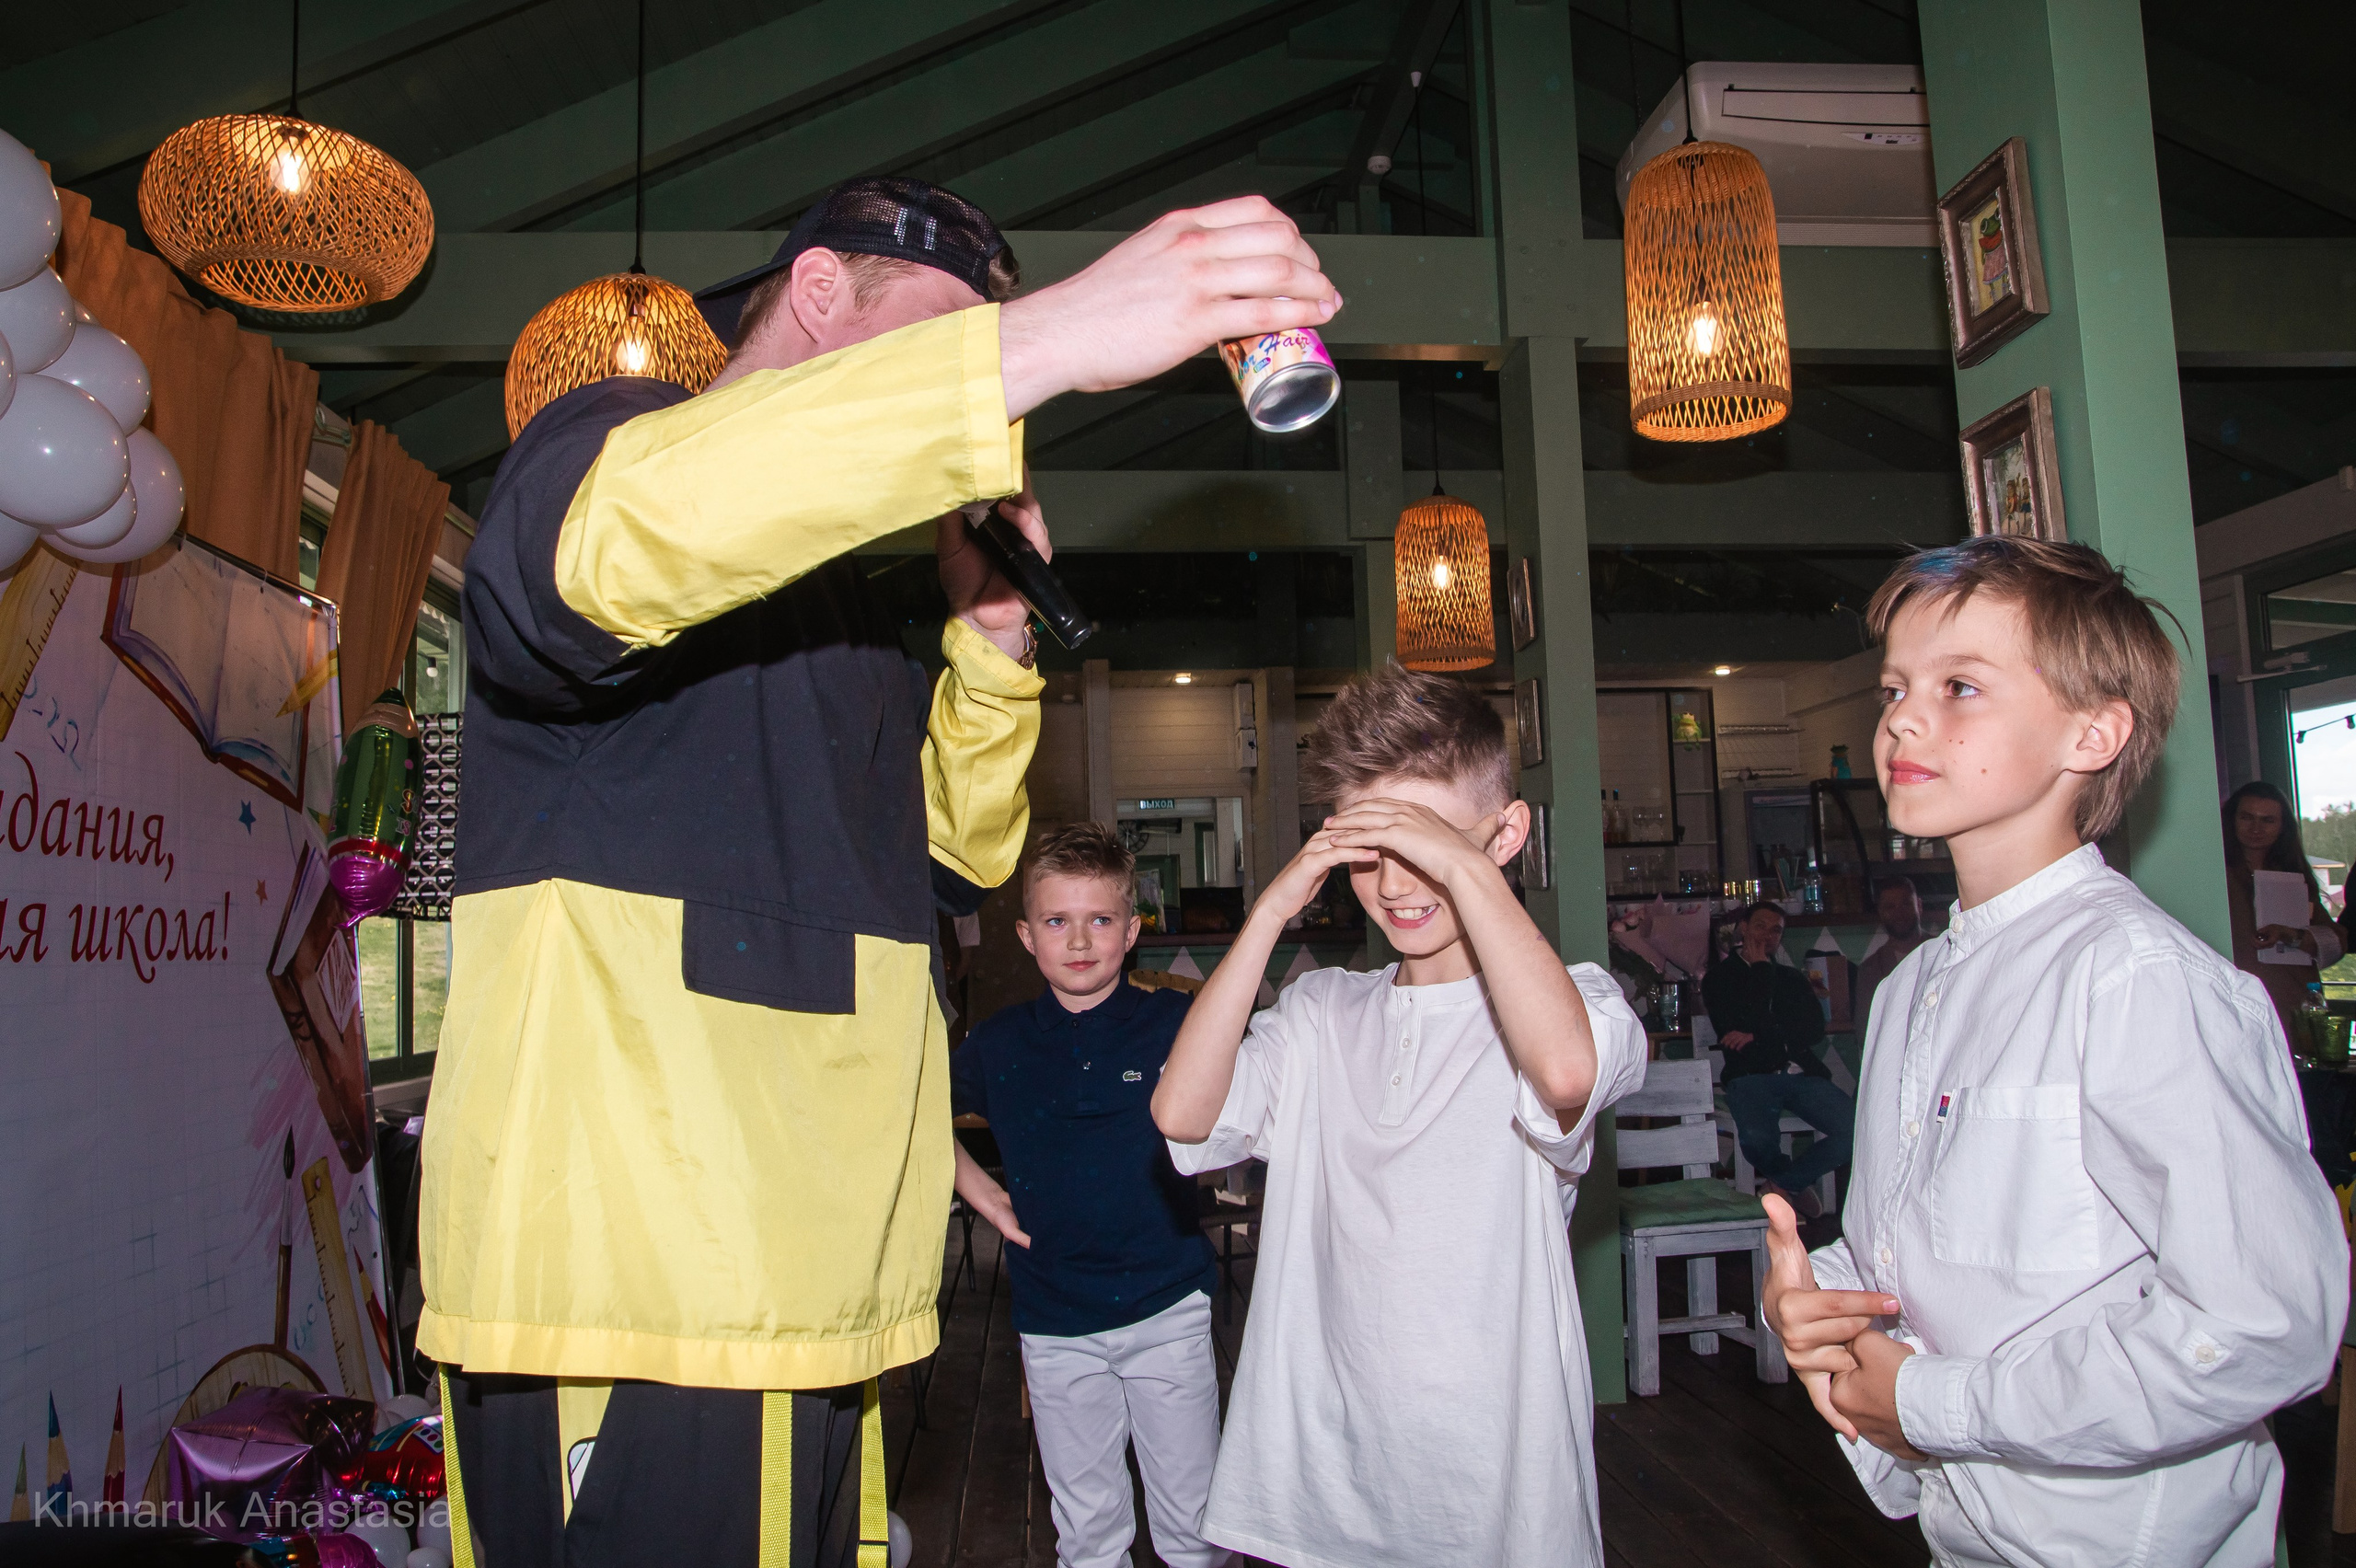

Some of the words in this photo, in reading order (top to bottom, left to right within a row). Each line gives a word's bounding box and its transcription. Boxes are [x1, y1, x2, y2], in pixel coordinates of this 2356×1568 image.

[1258, 333, 1311, 356] Hair
[0, 751, 175, 883] дания,
[1140, 800, 1174, 810] ВЫХОД
[69, 891, 231, 984] школа!
